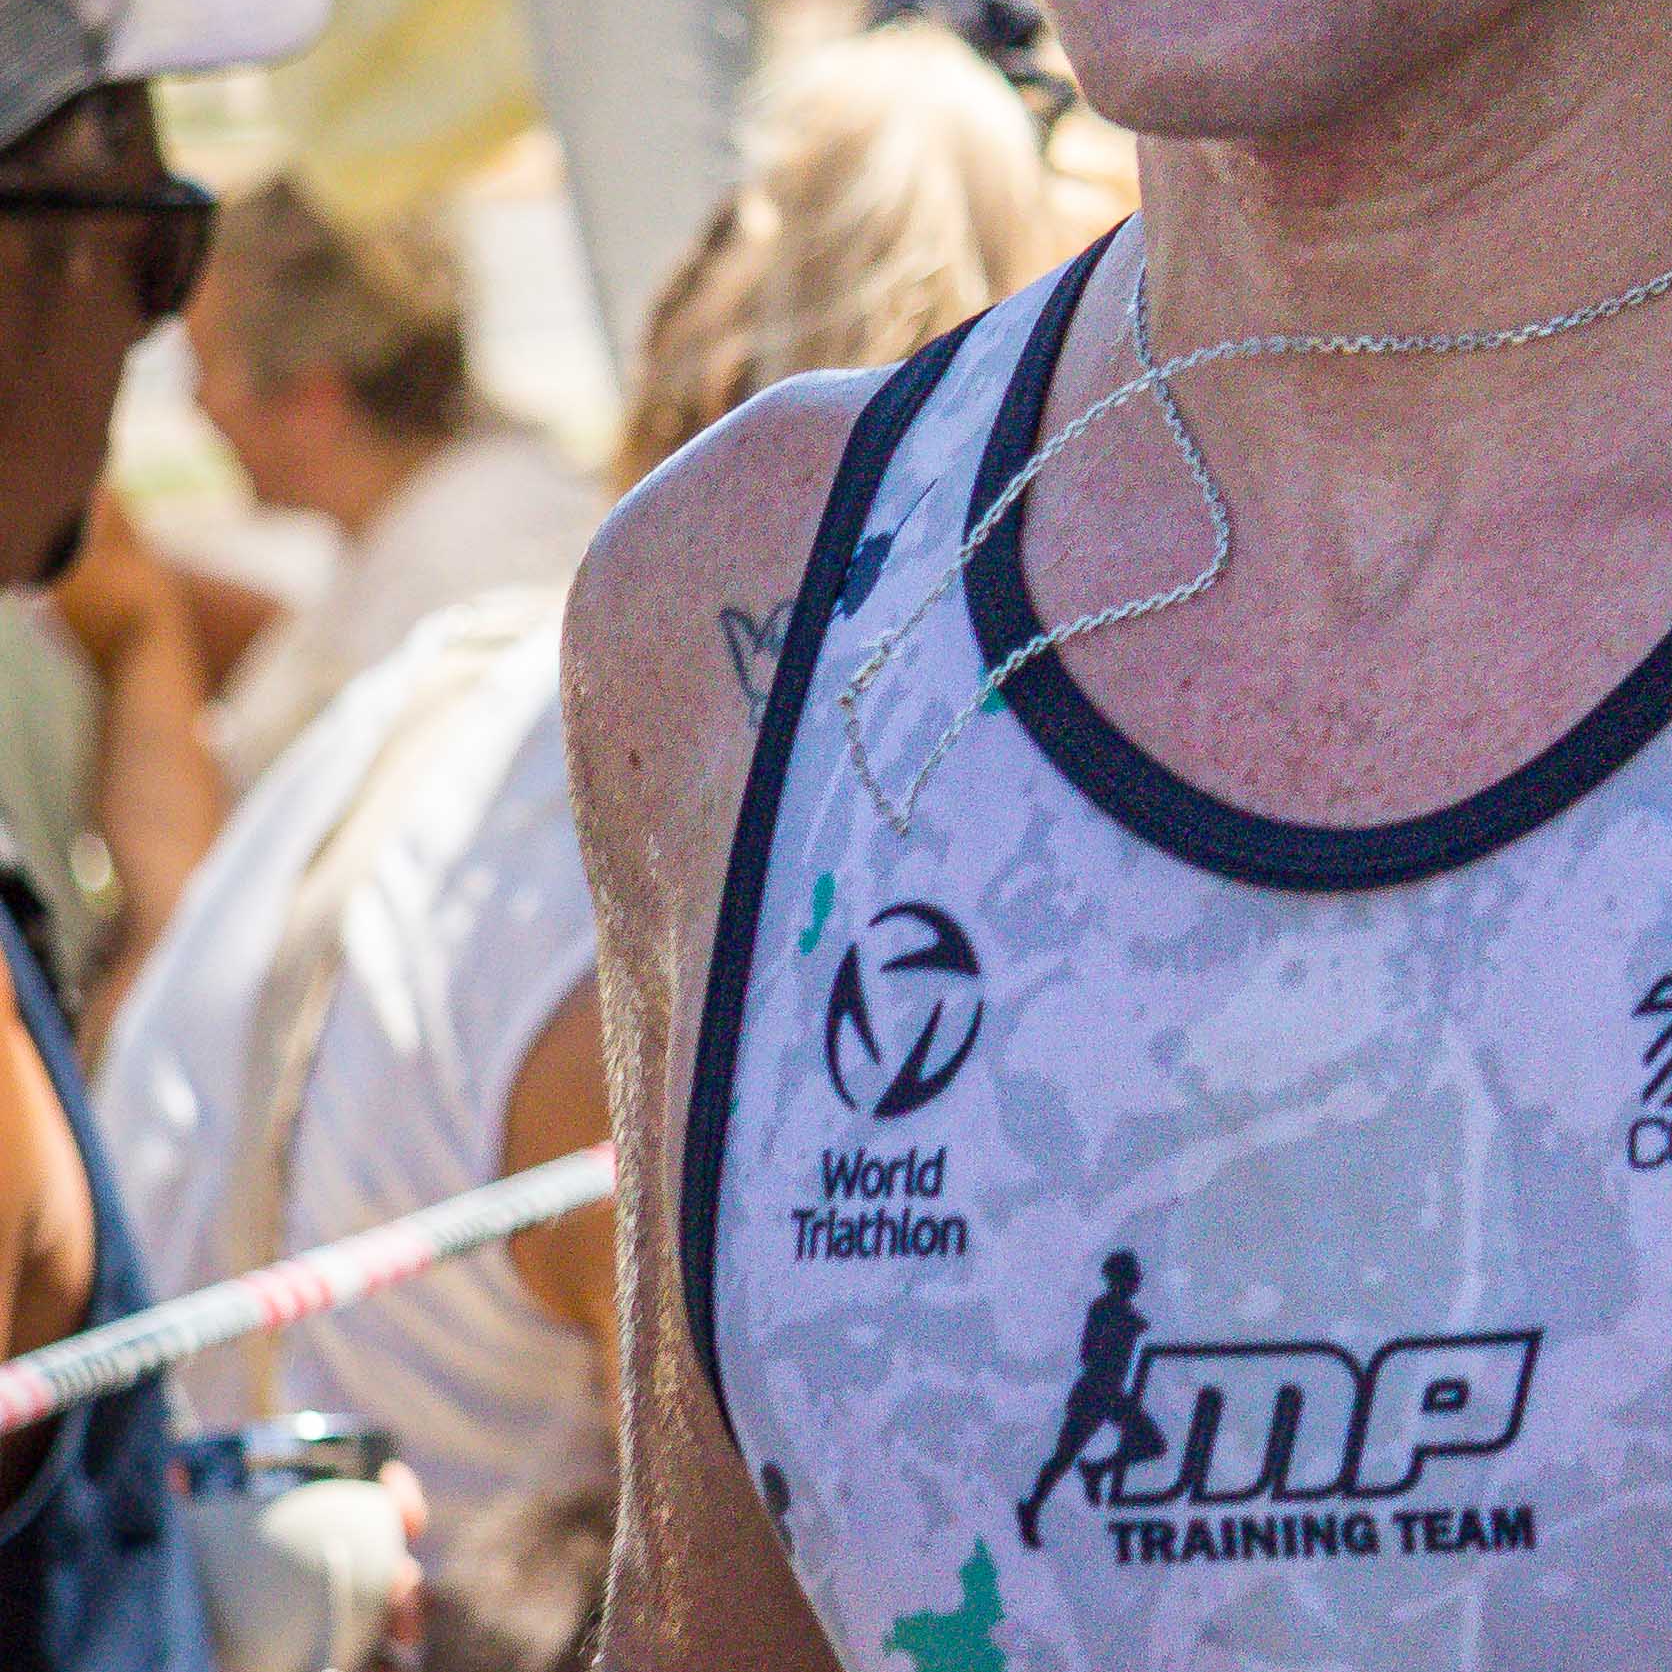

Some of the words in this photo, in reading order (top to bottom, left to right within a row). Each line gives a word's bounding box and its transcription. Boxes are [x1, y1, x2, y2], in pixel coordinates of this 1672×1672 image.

[822, 1147, 946, 1201] World
[790, 1205, 968, 1261] Triathlon
[1108, 1512, 1378, 1565] TRAINING
[1394, 1505, 1538, 1553] TEAM
